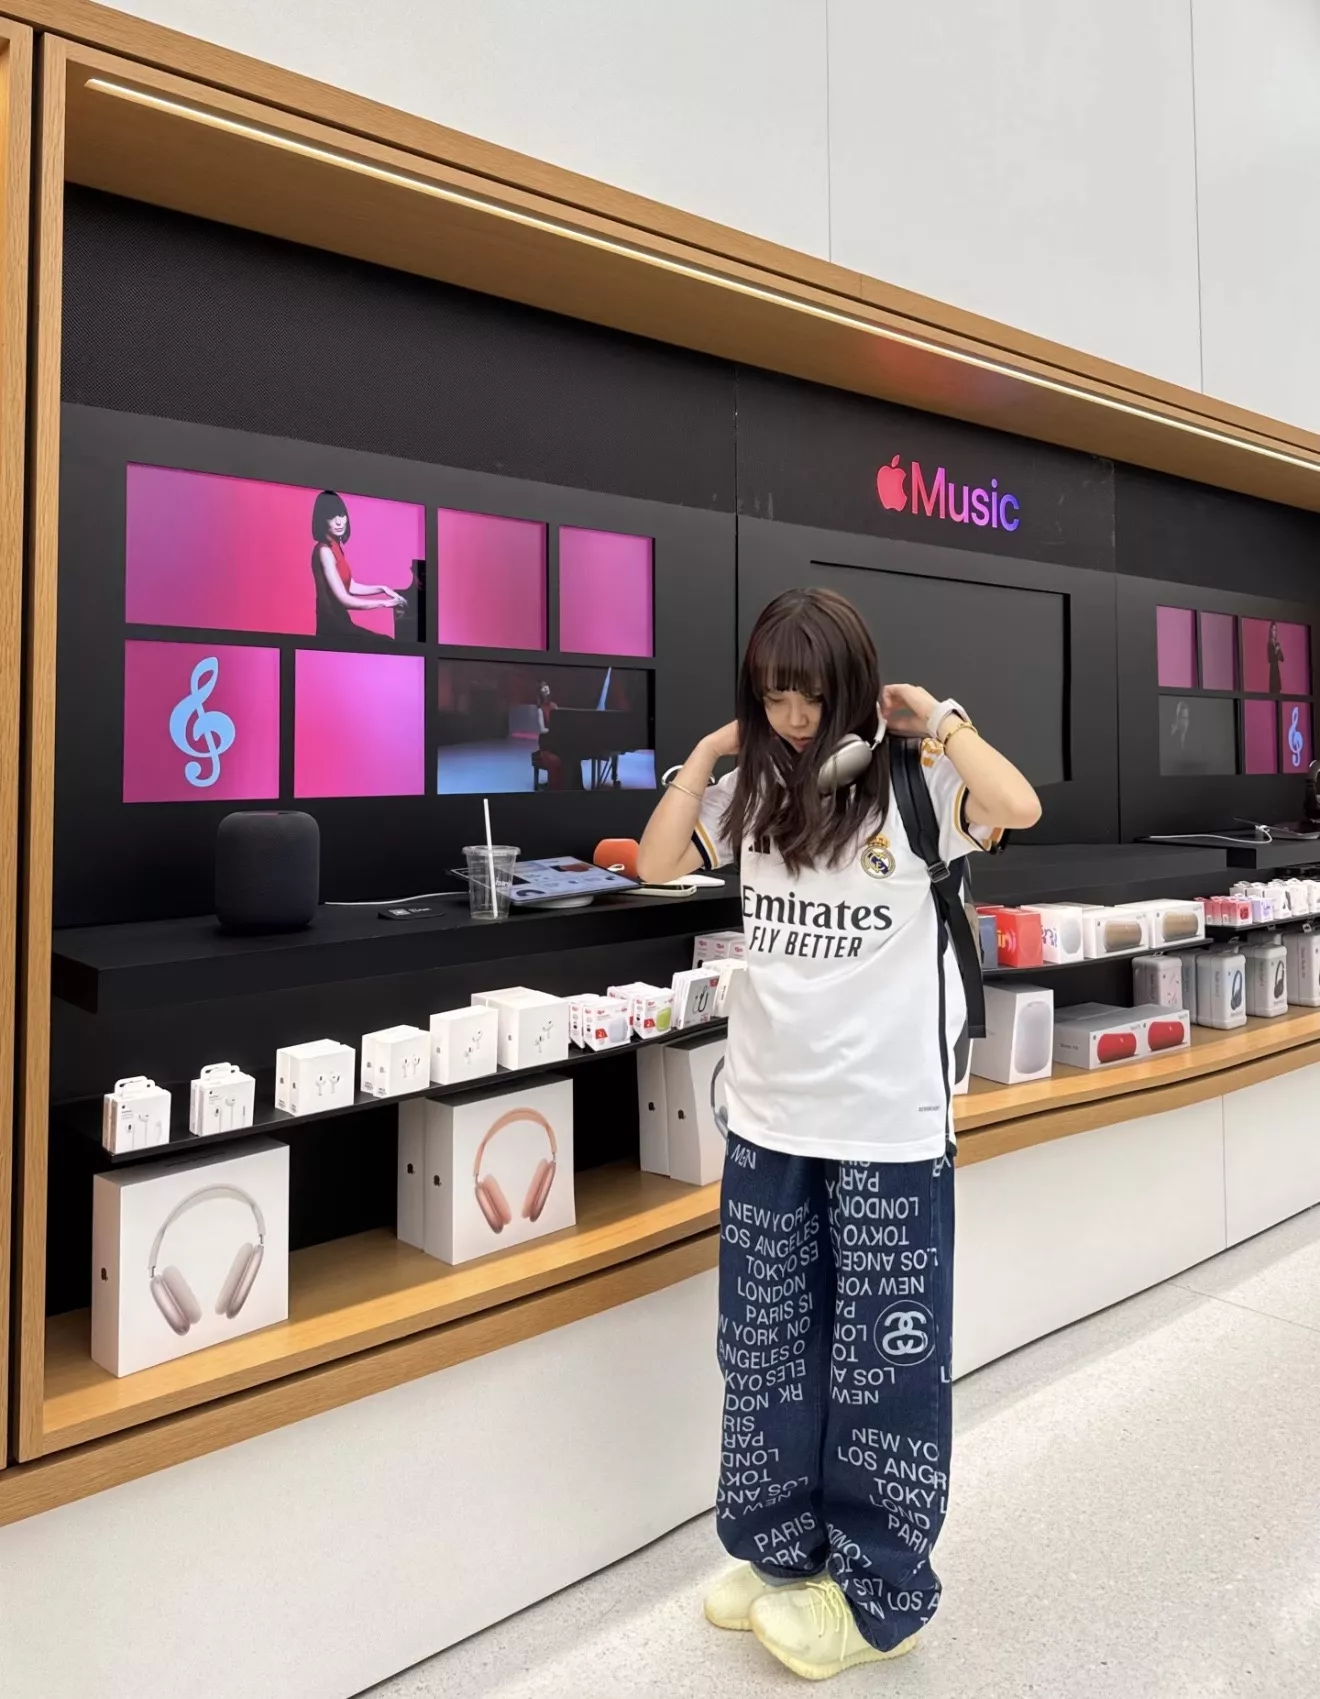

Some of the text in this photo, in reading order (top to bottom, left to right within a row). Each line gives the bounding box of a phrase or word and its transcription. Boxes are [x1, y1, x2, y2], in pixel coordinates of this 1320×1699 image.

[911, 461, 1019, 532] Music
[742, 885, 893, 931] Emirates
[749, 926, 780, 953] FLY
[785, 931, 863, 959] BETTER
[840, 1195, 919, 1219] LONDON
[843, 1224, 910, 1246] TOKYO
[746, 1254, 797, 1281] TOKYO
[737, 1272, 806, 1304] LONDON
[878, 1275, 925, 1296] NEW
[746, 1300, 794, 1325] PARIS
[732, 1321, 779, 1346] YORK
[832, 1386, 880, 1405] NEW
[852, 1428, 900, 1453] NEW
[838, 1445, 878, 1471] LOS
[753, 1512, 815, 1553] PARIS
[887, 1591, 923, 1612] LOS
